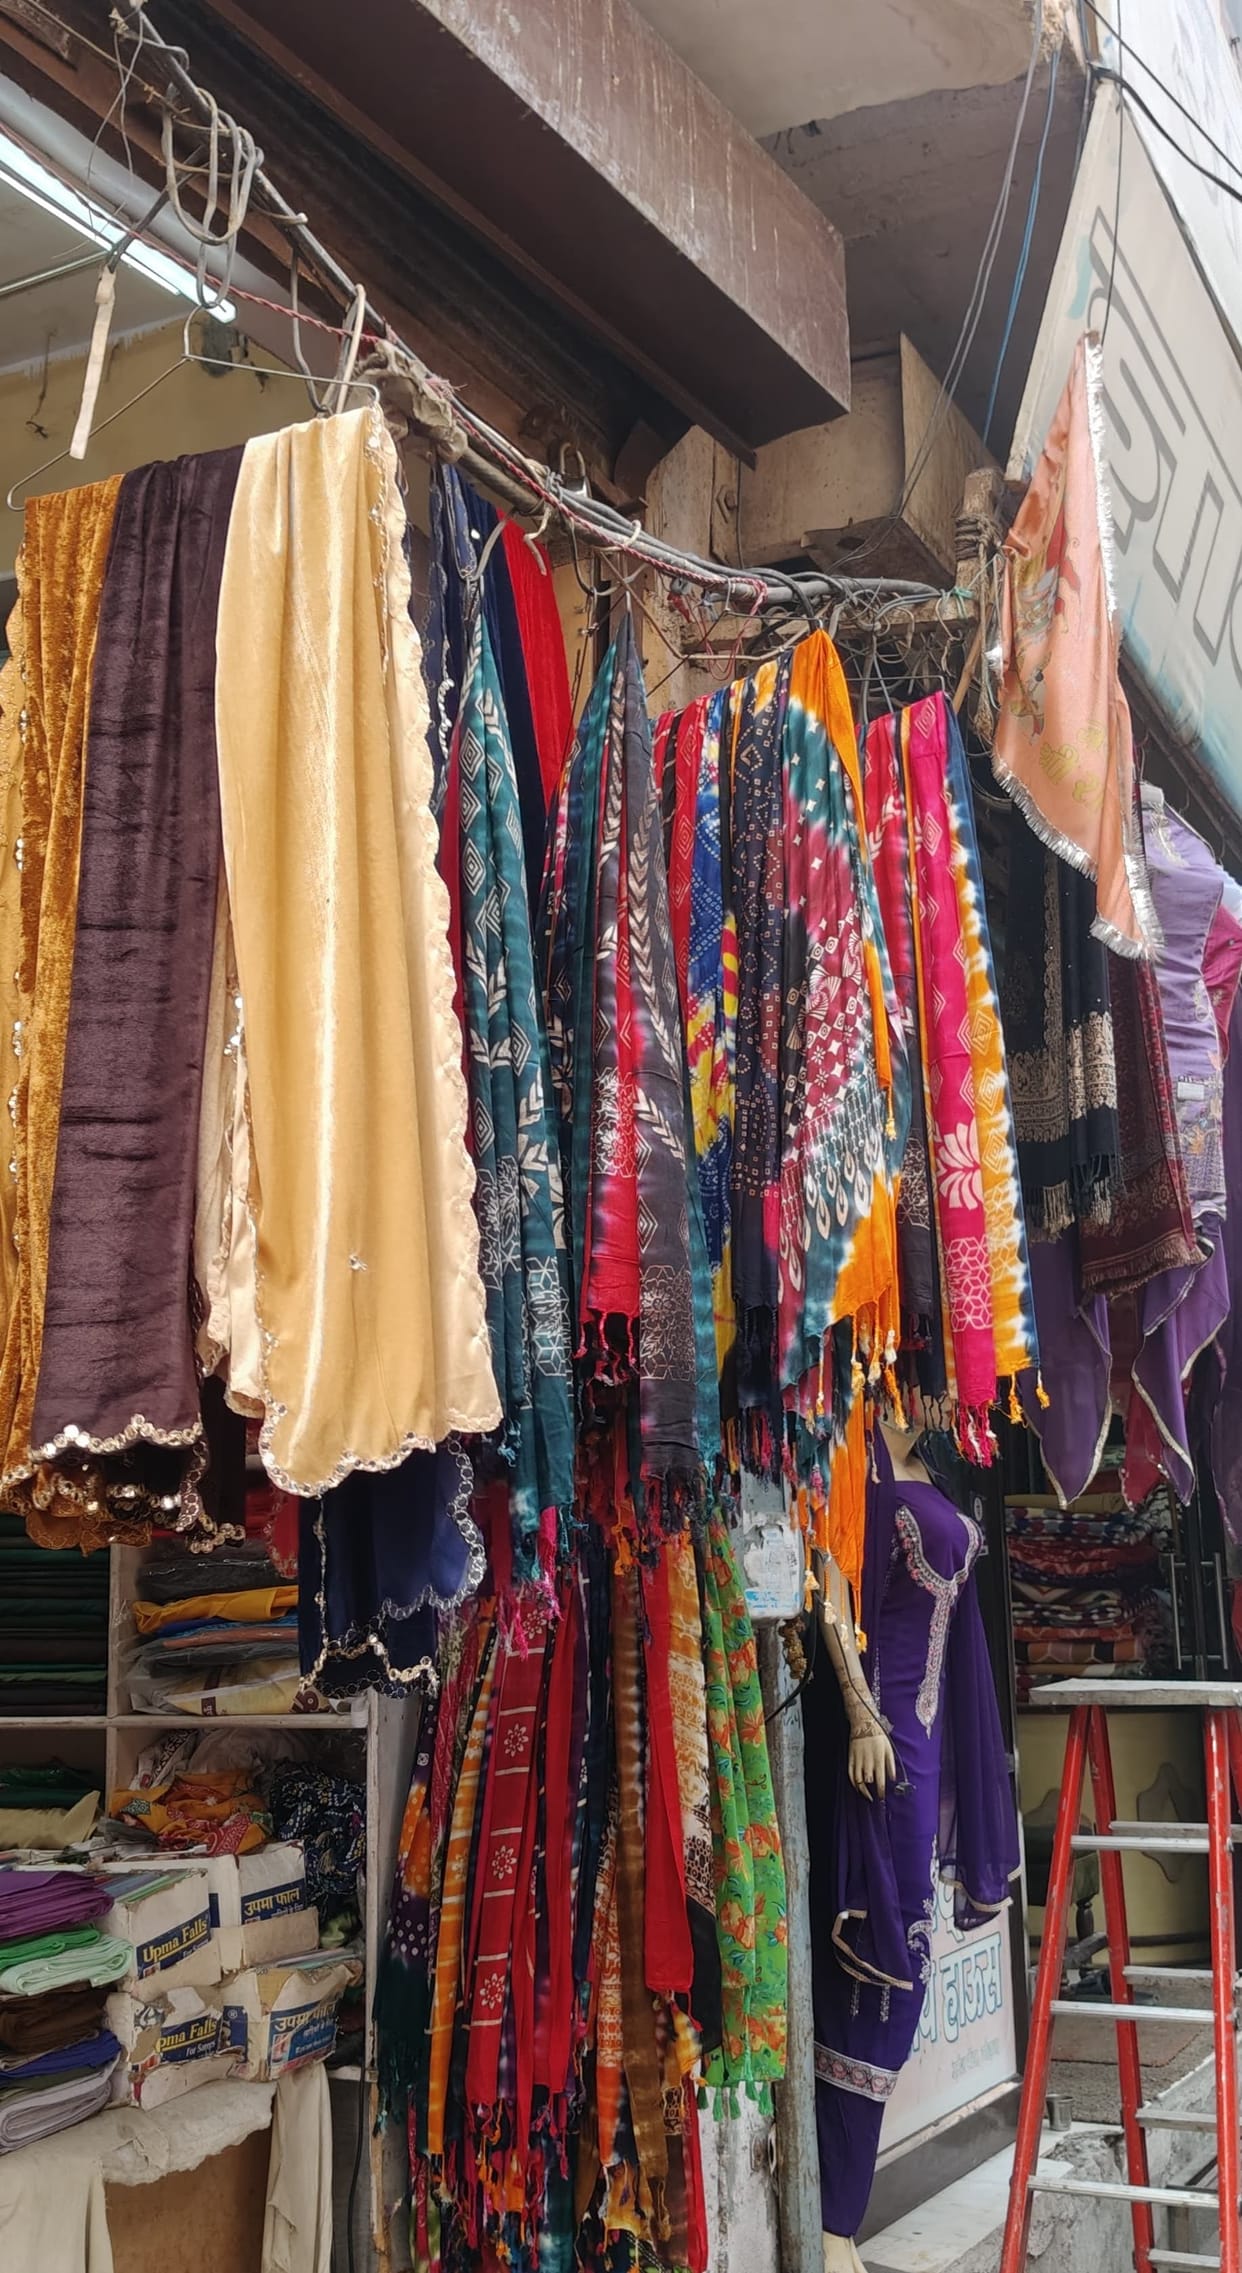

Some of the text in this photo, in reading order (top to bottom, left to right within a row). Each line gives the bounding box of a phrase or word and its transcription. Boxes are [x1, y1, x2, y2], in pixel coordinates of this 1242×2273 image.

[143, 1937, 179, 1963] Upma
[182, 1918, 208, 1944] Falls
[155, 2017, 217, 2054] pma Falls
